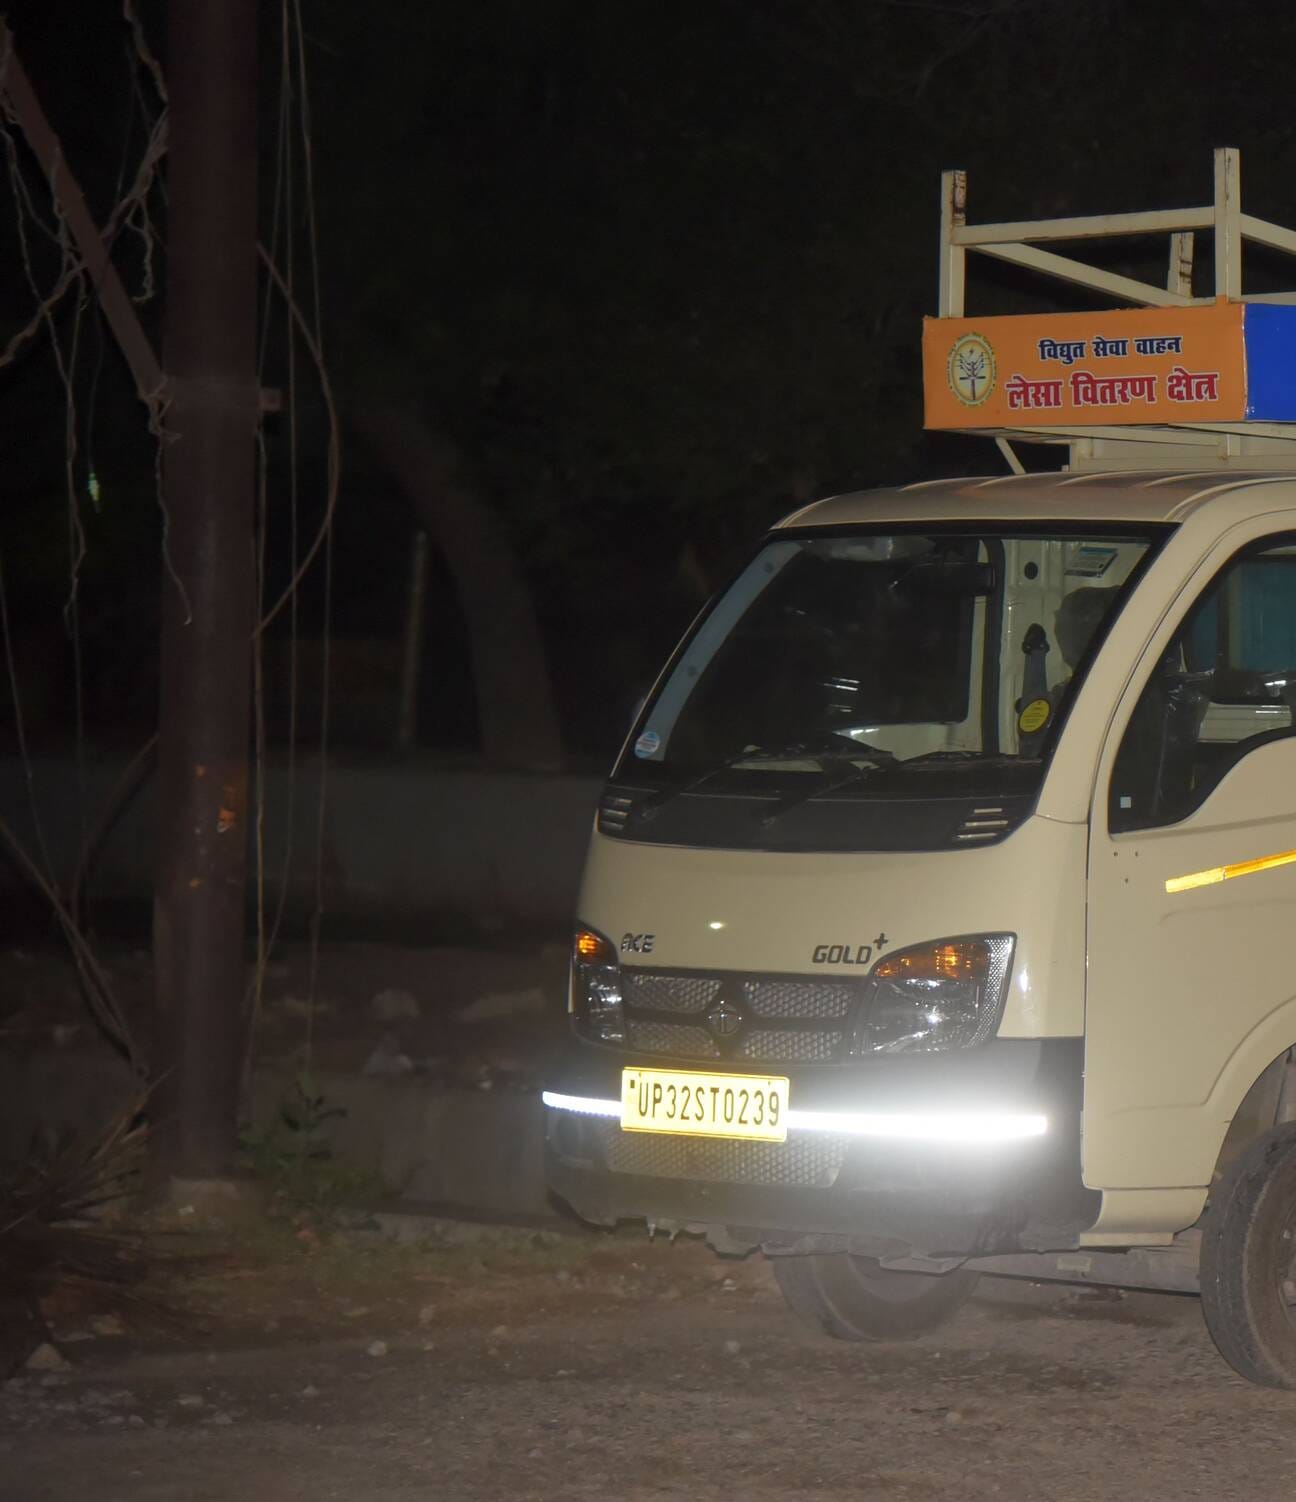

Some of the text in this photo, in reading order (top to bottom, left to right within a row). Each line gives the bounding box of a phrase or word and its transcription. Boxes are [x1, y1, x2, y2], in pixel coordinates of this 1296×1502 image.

[1038, 336, 1181, 365] विद्युत सेवा वाहन
[1005, 375, 1063, 408] लेसा
[1070, 371, 1156, 406] वितरण
[620, 933, 656, 953] ACE
[637, 1080, 780, 1126] UP32ST0239
